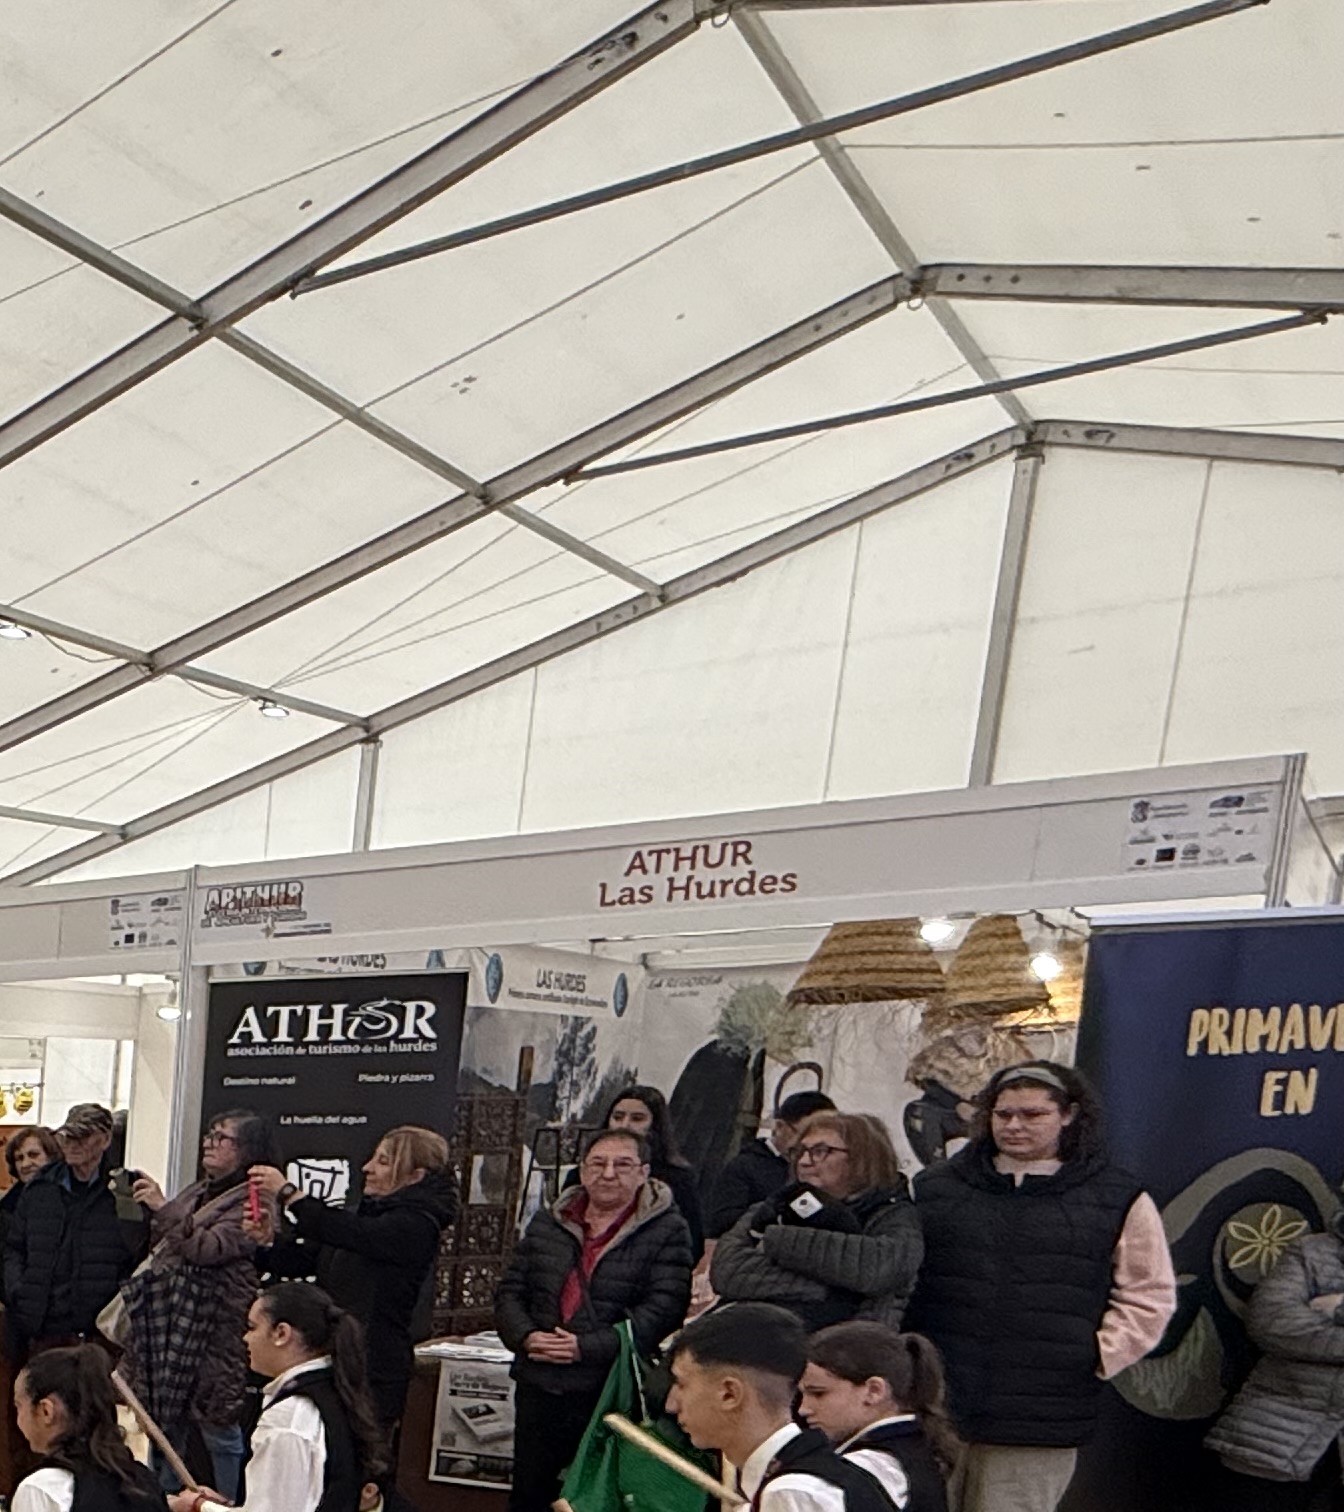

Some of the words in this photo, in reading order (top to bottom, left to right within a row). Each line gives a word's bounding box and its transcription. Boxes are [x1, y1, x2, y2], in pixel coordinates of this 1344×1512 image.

[623, 840, 753, 877] ATHUR
[598, 881, 655, 908] Las
[666, 869, 798, 903] Hurdes
[227, 1044, 294, 1057] asociación
[308, 1043, 361, 1055] turismo
[389, 1040, 438, 1053] hurdes
[261, 1076, 296, 1086] natural
[1261, 1067, 1318, 1117] EN
[280, 1115, 292, 1124] La
[324, 1115, 340, 1124] del
